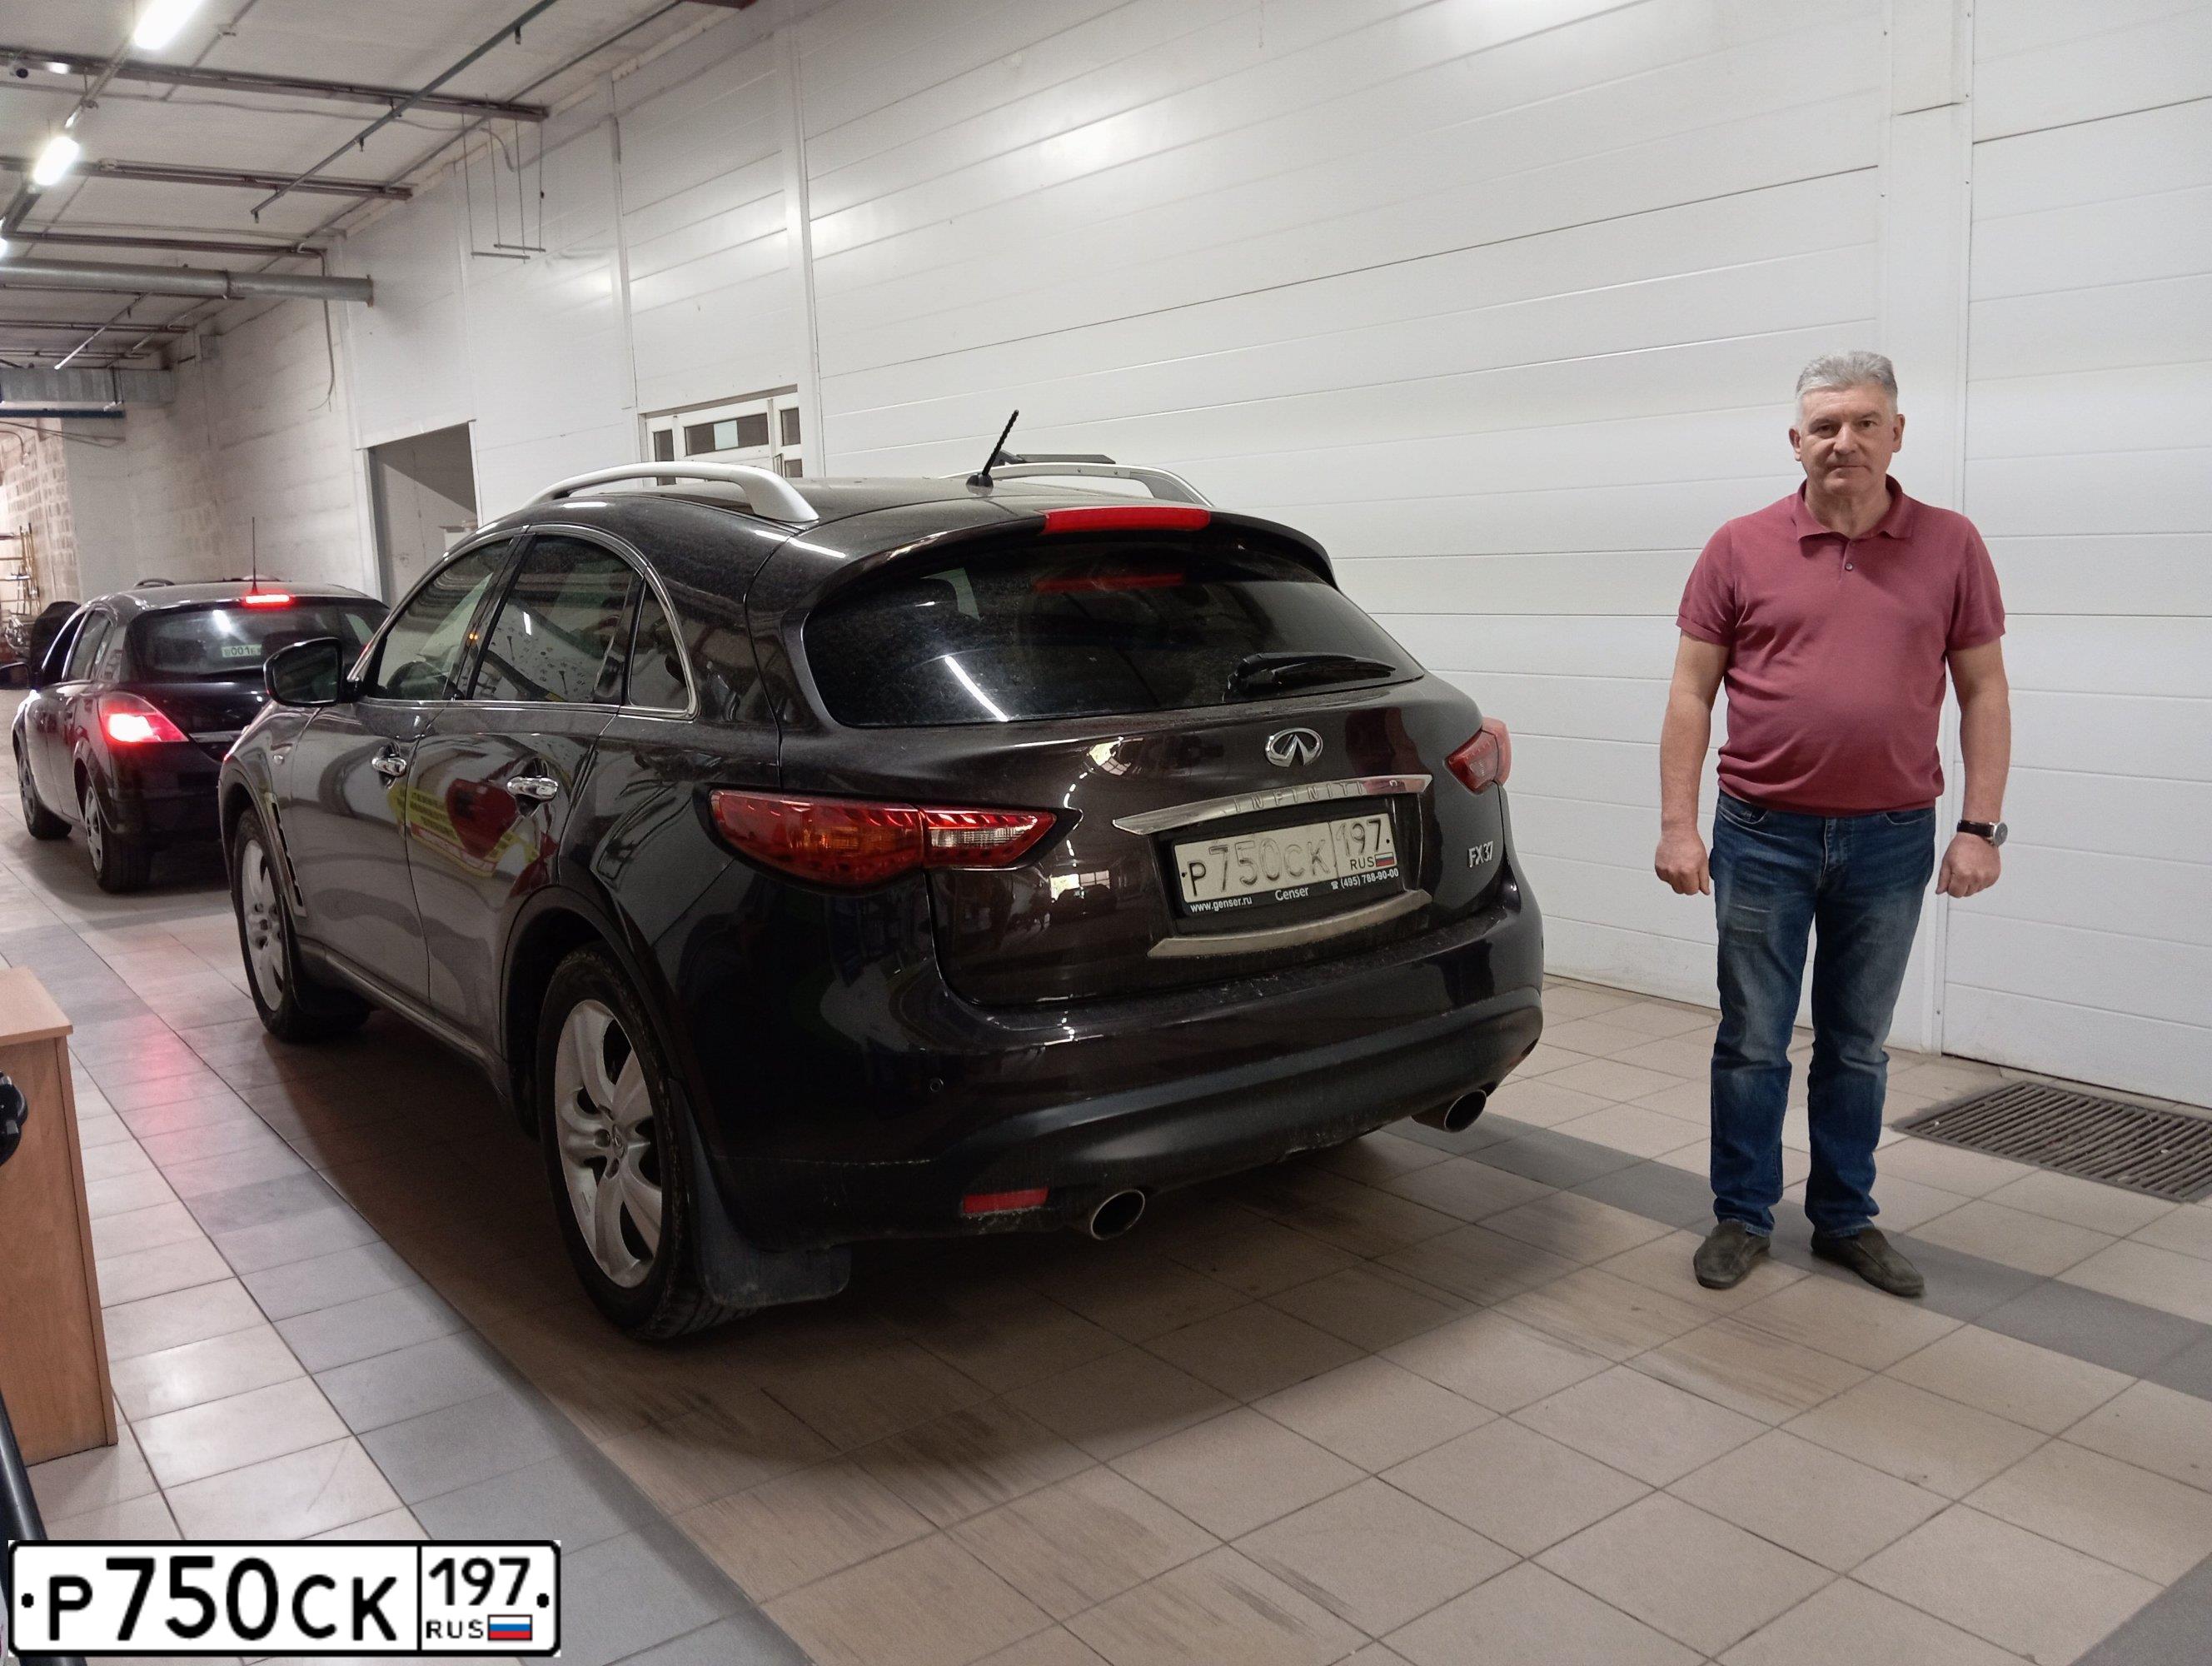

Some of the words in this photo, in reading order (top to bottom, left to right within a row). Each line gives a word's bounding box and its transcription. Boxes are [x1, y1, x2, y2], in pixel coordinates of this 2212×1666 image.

[1233, 781, 1363, 814] INFINITI
[1336, 818, 1381, 856] 197
[1349, 856, 1375, 870] RUS
[1468, 840, 1493, 868] FX37
[1190, 896, 1253, 912] www.genser.ru
[1340, 874, 1361, 890] (495)
[1362, 868, 1399, 884] 788-90-00
